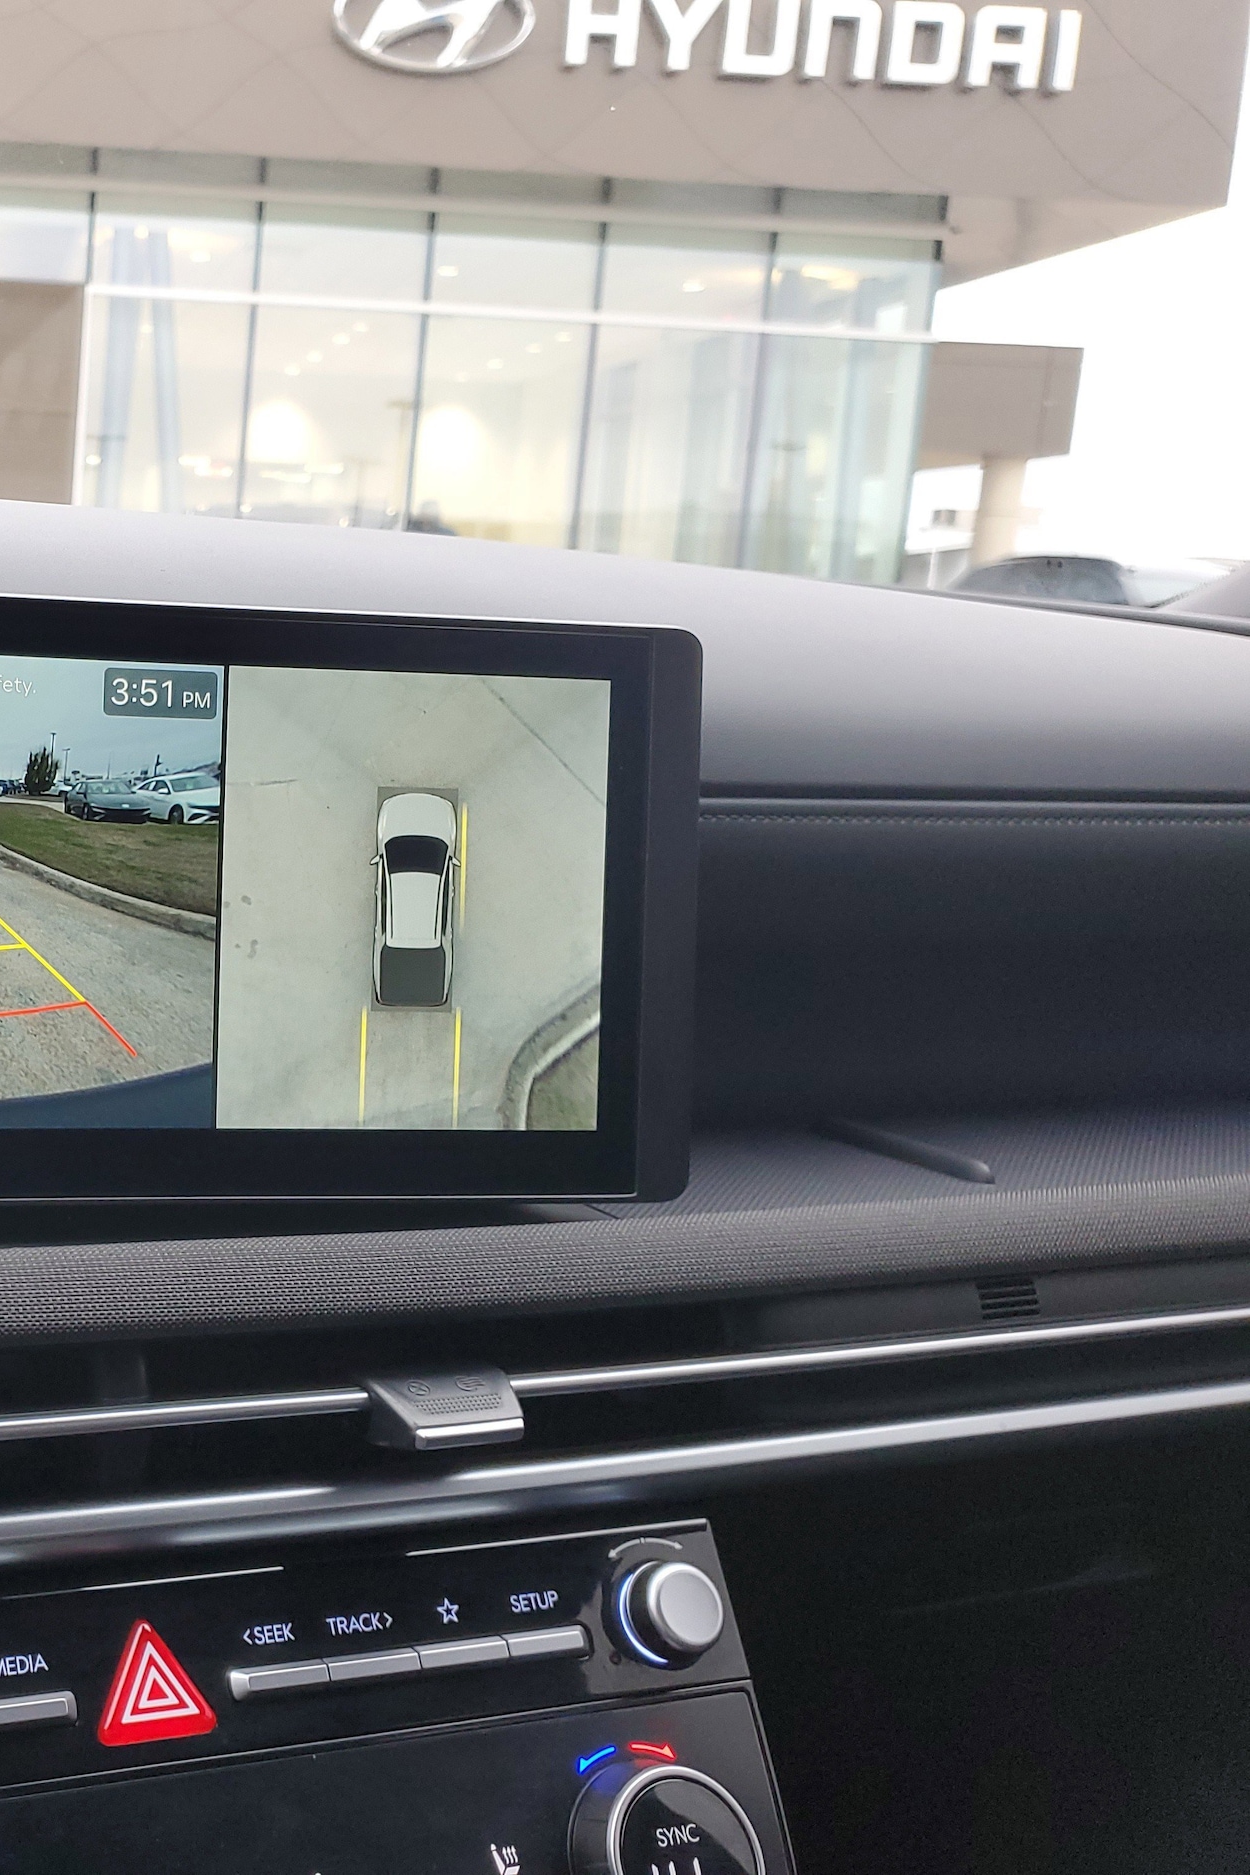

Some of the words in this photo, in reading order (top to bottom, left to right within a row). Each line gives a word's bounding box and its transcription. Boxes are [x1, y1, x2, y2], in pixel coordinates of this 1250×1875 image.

[563, 0, 1083, 92] HYUNDAI
[110, 677, 174, 708] 3:51
[182, 690, 211, 709] PM
[510, 1590, 559, 1614] SETUP
[656, 1823, 700, 1848] SYNC
